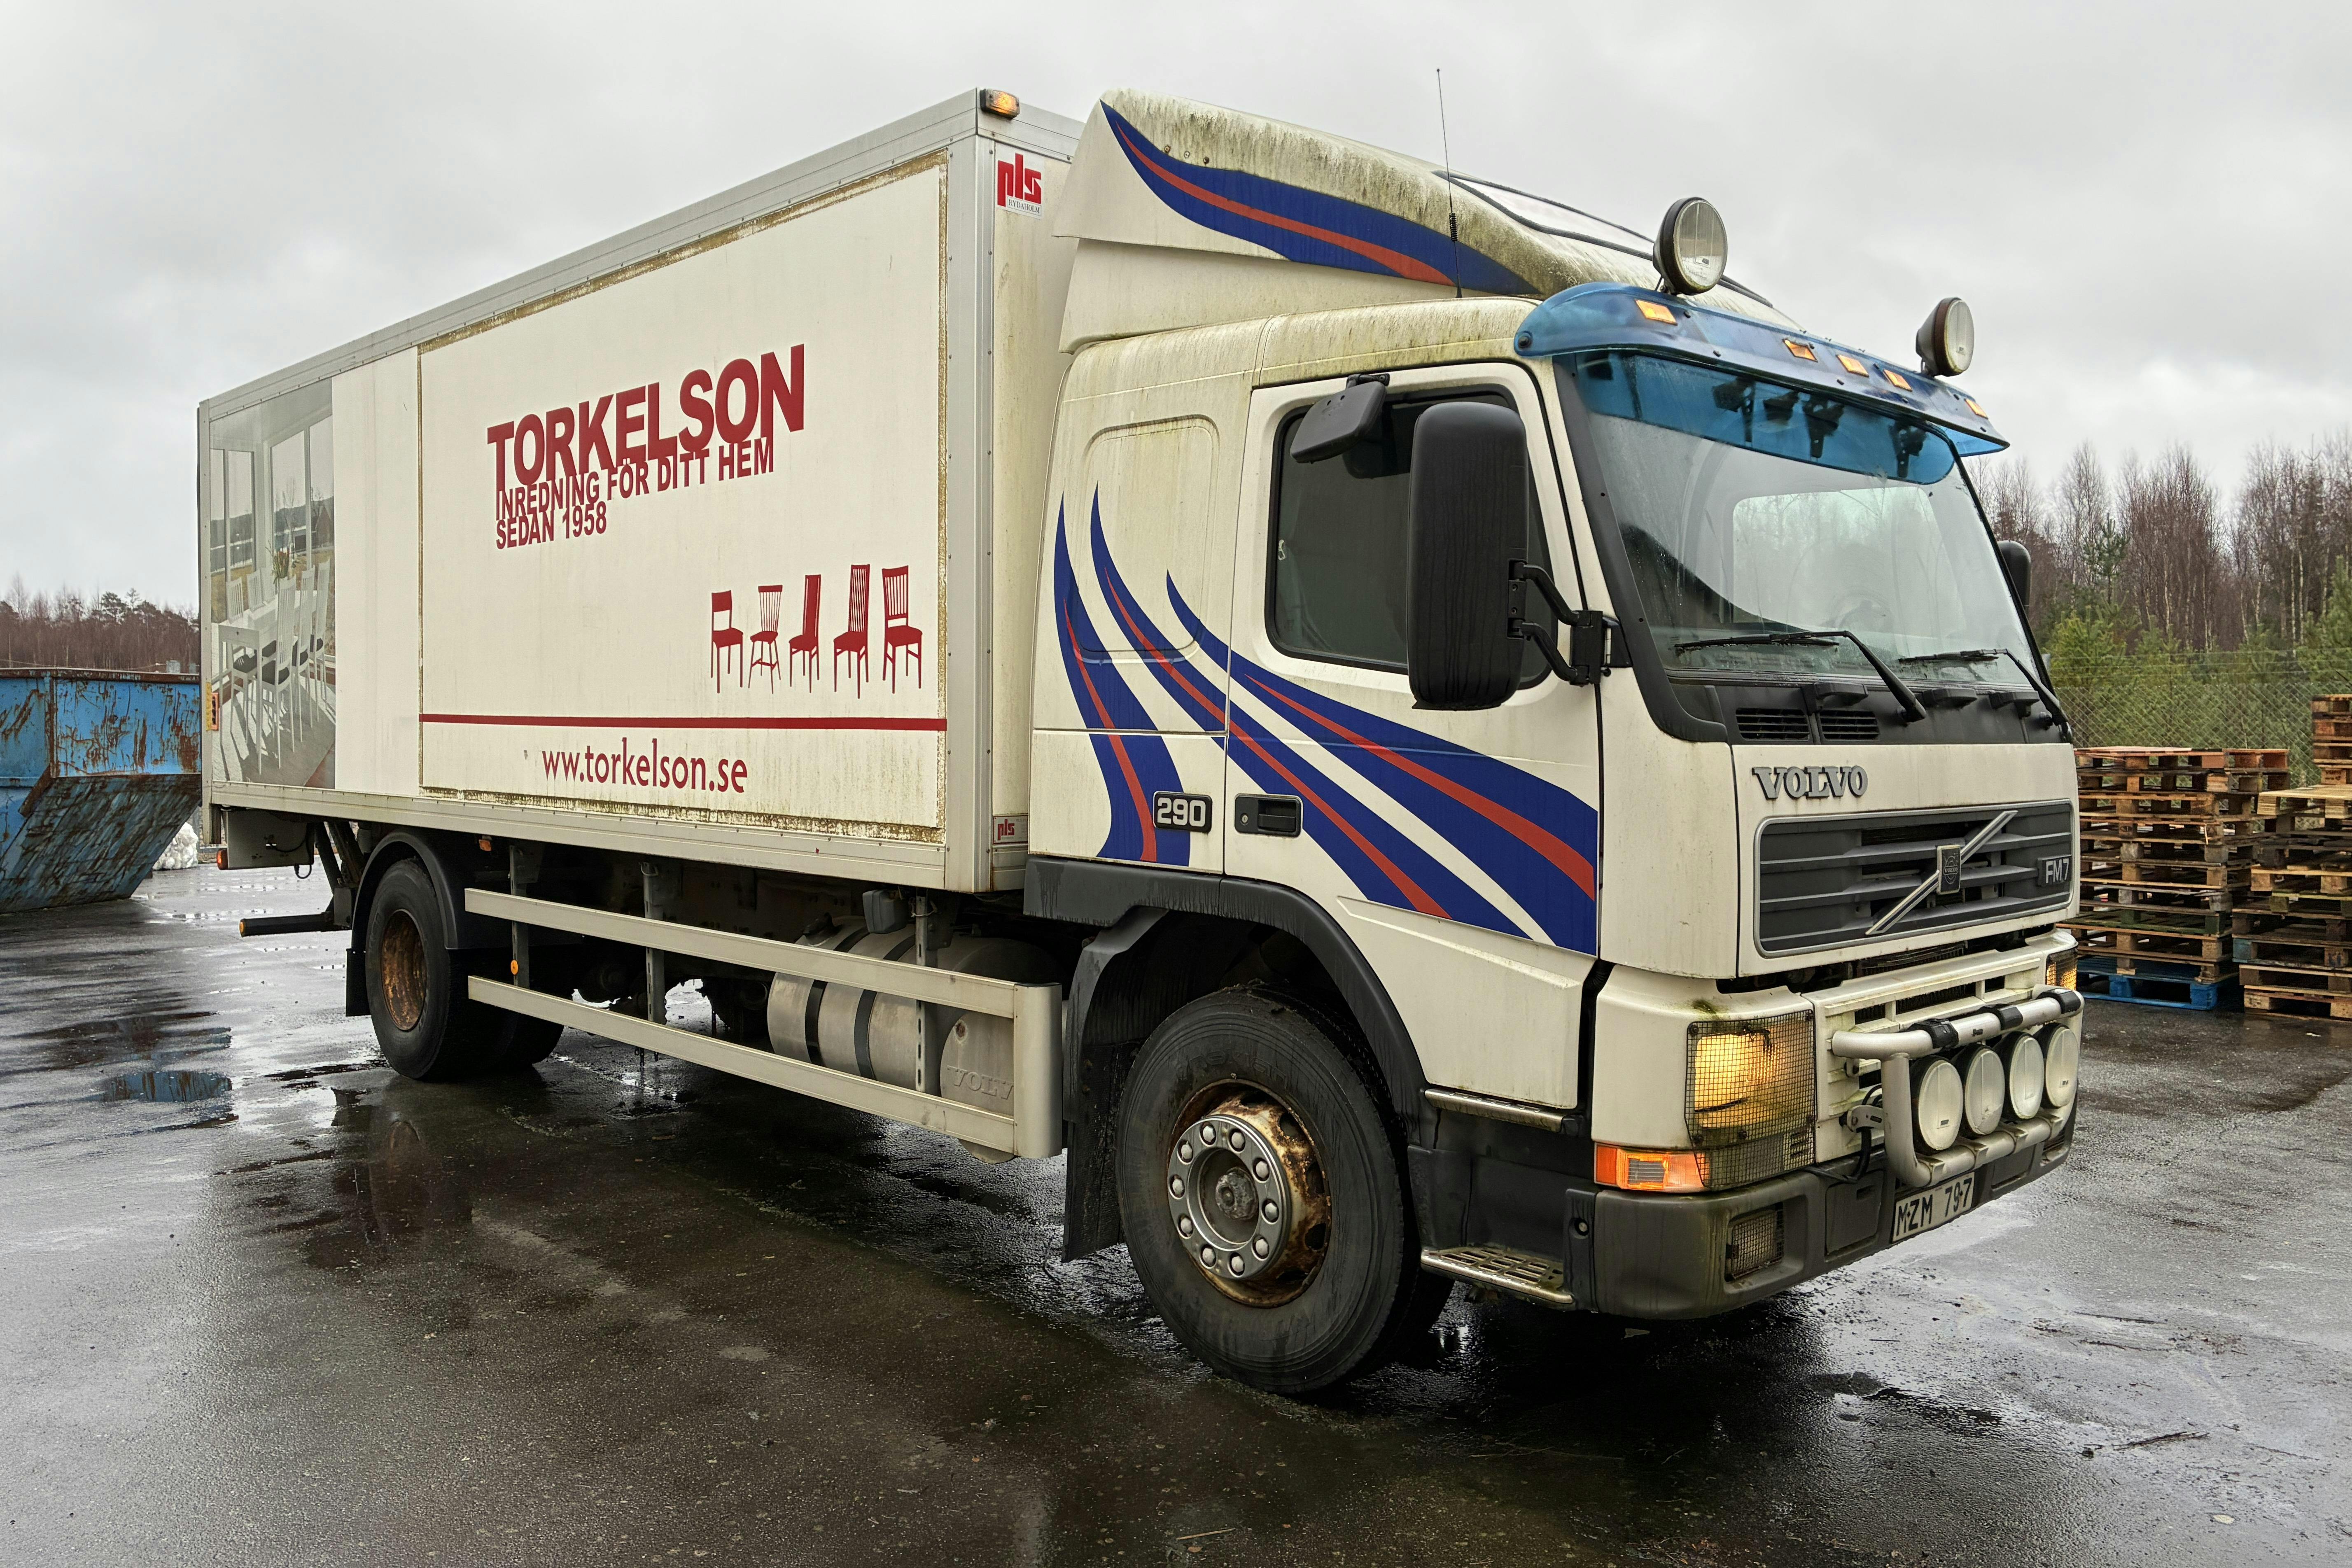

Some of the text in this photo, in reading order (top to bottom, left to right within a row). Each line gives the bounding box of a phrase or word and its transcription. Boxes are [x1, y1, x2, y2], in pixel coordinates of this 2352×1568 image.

[997, 153, 1041, 207] pls
[1008, 199, 1040, 214] RYDAHOLM
[487, 343, 805, 491] TORKELSON
[496, 437, 774, 521] INREDNING FÖR DITT HEM
[496, 501, 607, 550] SEDAN 1958
[523, 737, 748, 793] ww.torkelson.se
[1752, 765, 1869, 800] VOLVO
[1157, 797, 1206, 827] 290
[2046, 858, 2069, 884] FM7
[947, 1065, 1014, 1100] VOLV
[1896, 1177, 1972, 1237] MZM 797
